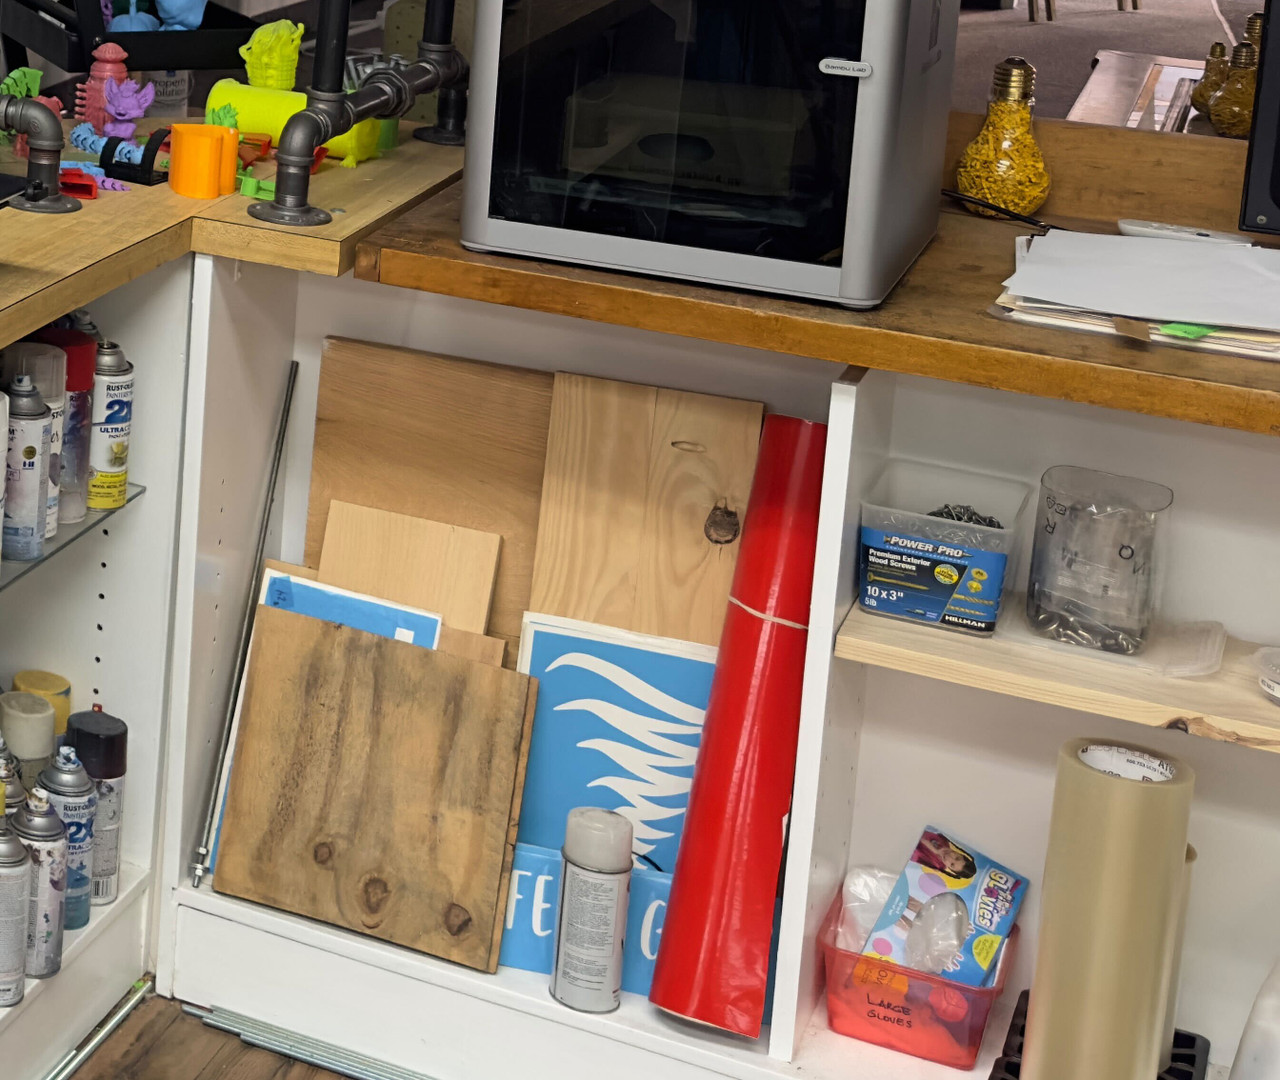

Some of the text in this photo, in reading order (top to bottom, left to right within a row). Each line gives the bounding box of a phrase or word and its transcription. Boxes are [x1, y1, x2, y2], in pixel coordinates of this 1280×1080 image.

[868, 556, 888, 566] Wood
[890, 560, 916, 571] Screws
[869, 549, 931, 567] Premium Exterior
[866, 585, 879, 597] 10
[945, 615, 986, 628] HILLMAN
[866, 993, 912, 1016] LARGE
[867, 1009, 913, 1029] GLOVES
